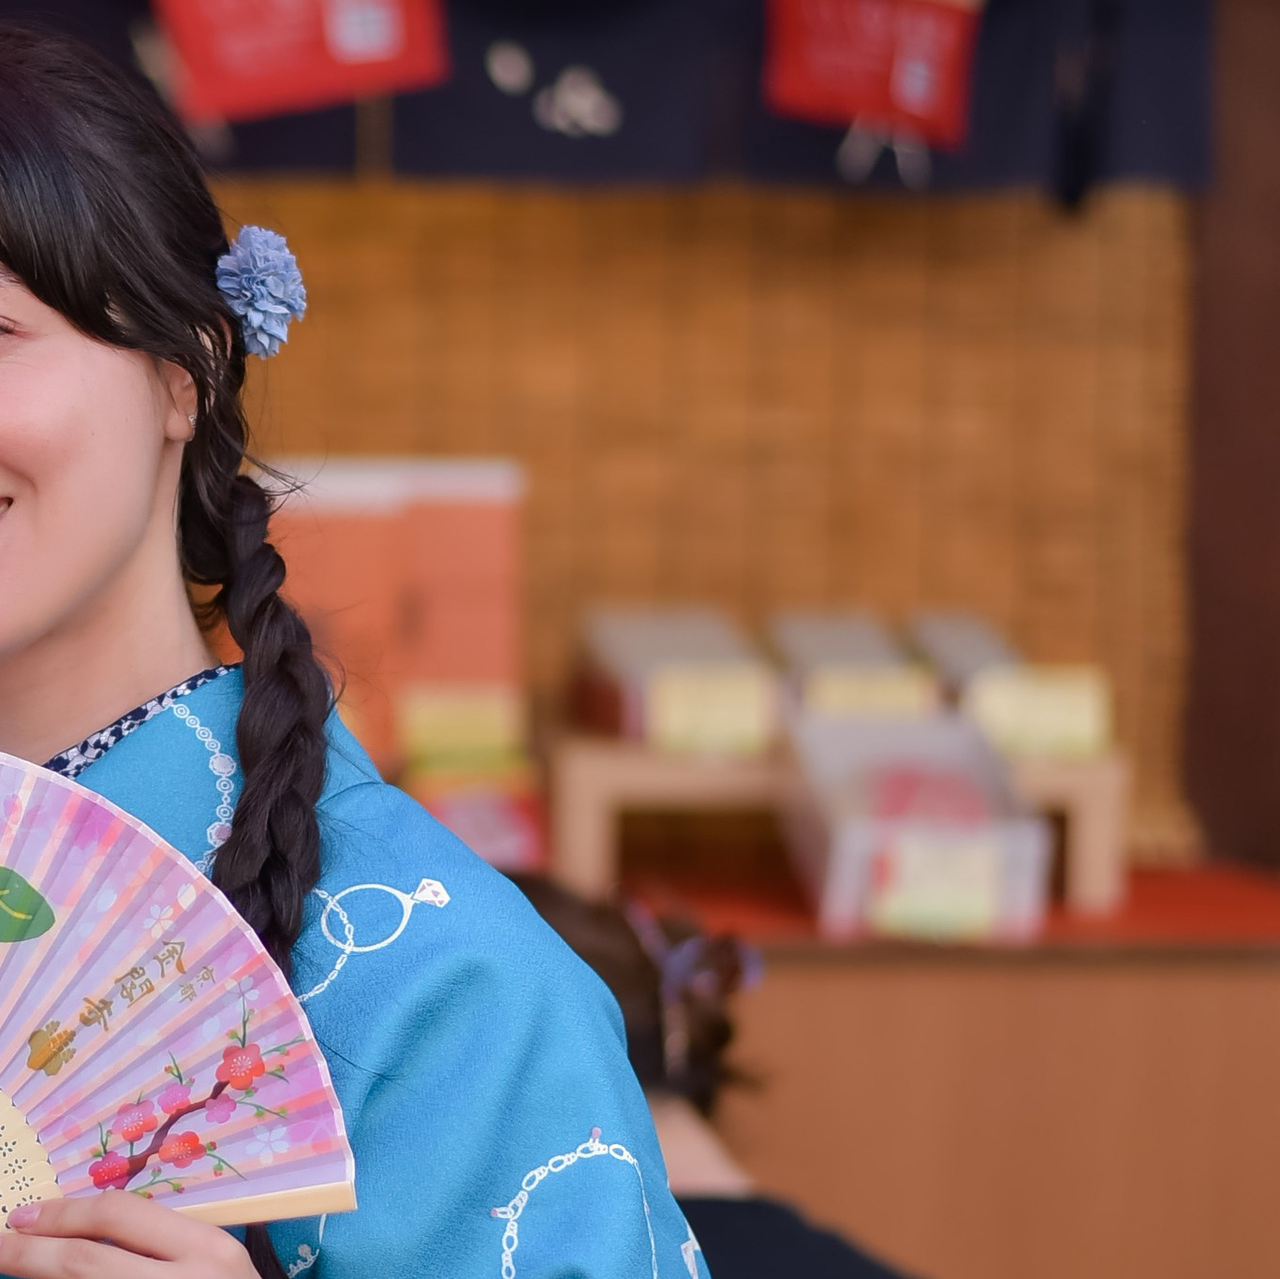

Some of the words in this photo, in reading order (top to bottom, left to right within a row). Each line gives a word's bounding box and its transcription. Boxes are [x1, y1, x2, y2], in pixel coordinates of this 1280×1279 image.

[80, 940, 187, 1032] 金閣寺
[177, 965, 217, 1004] 京都
